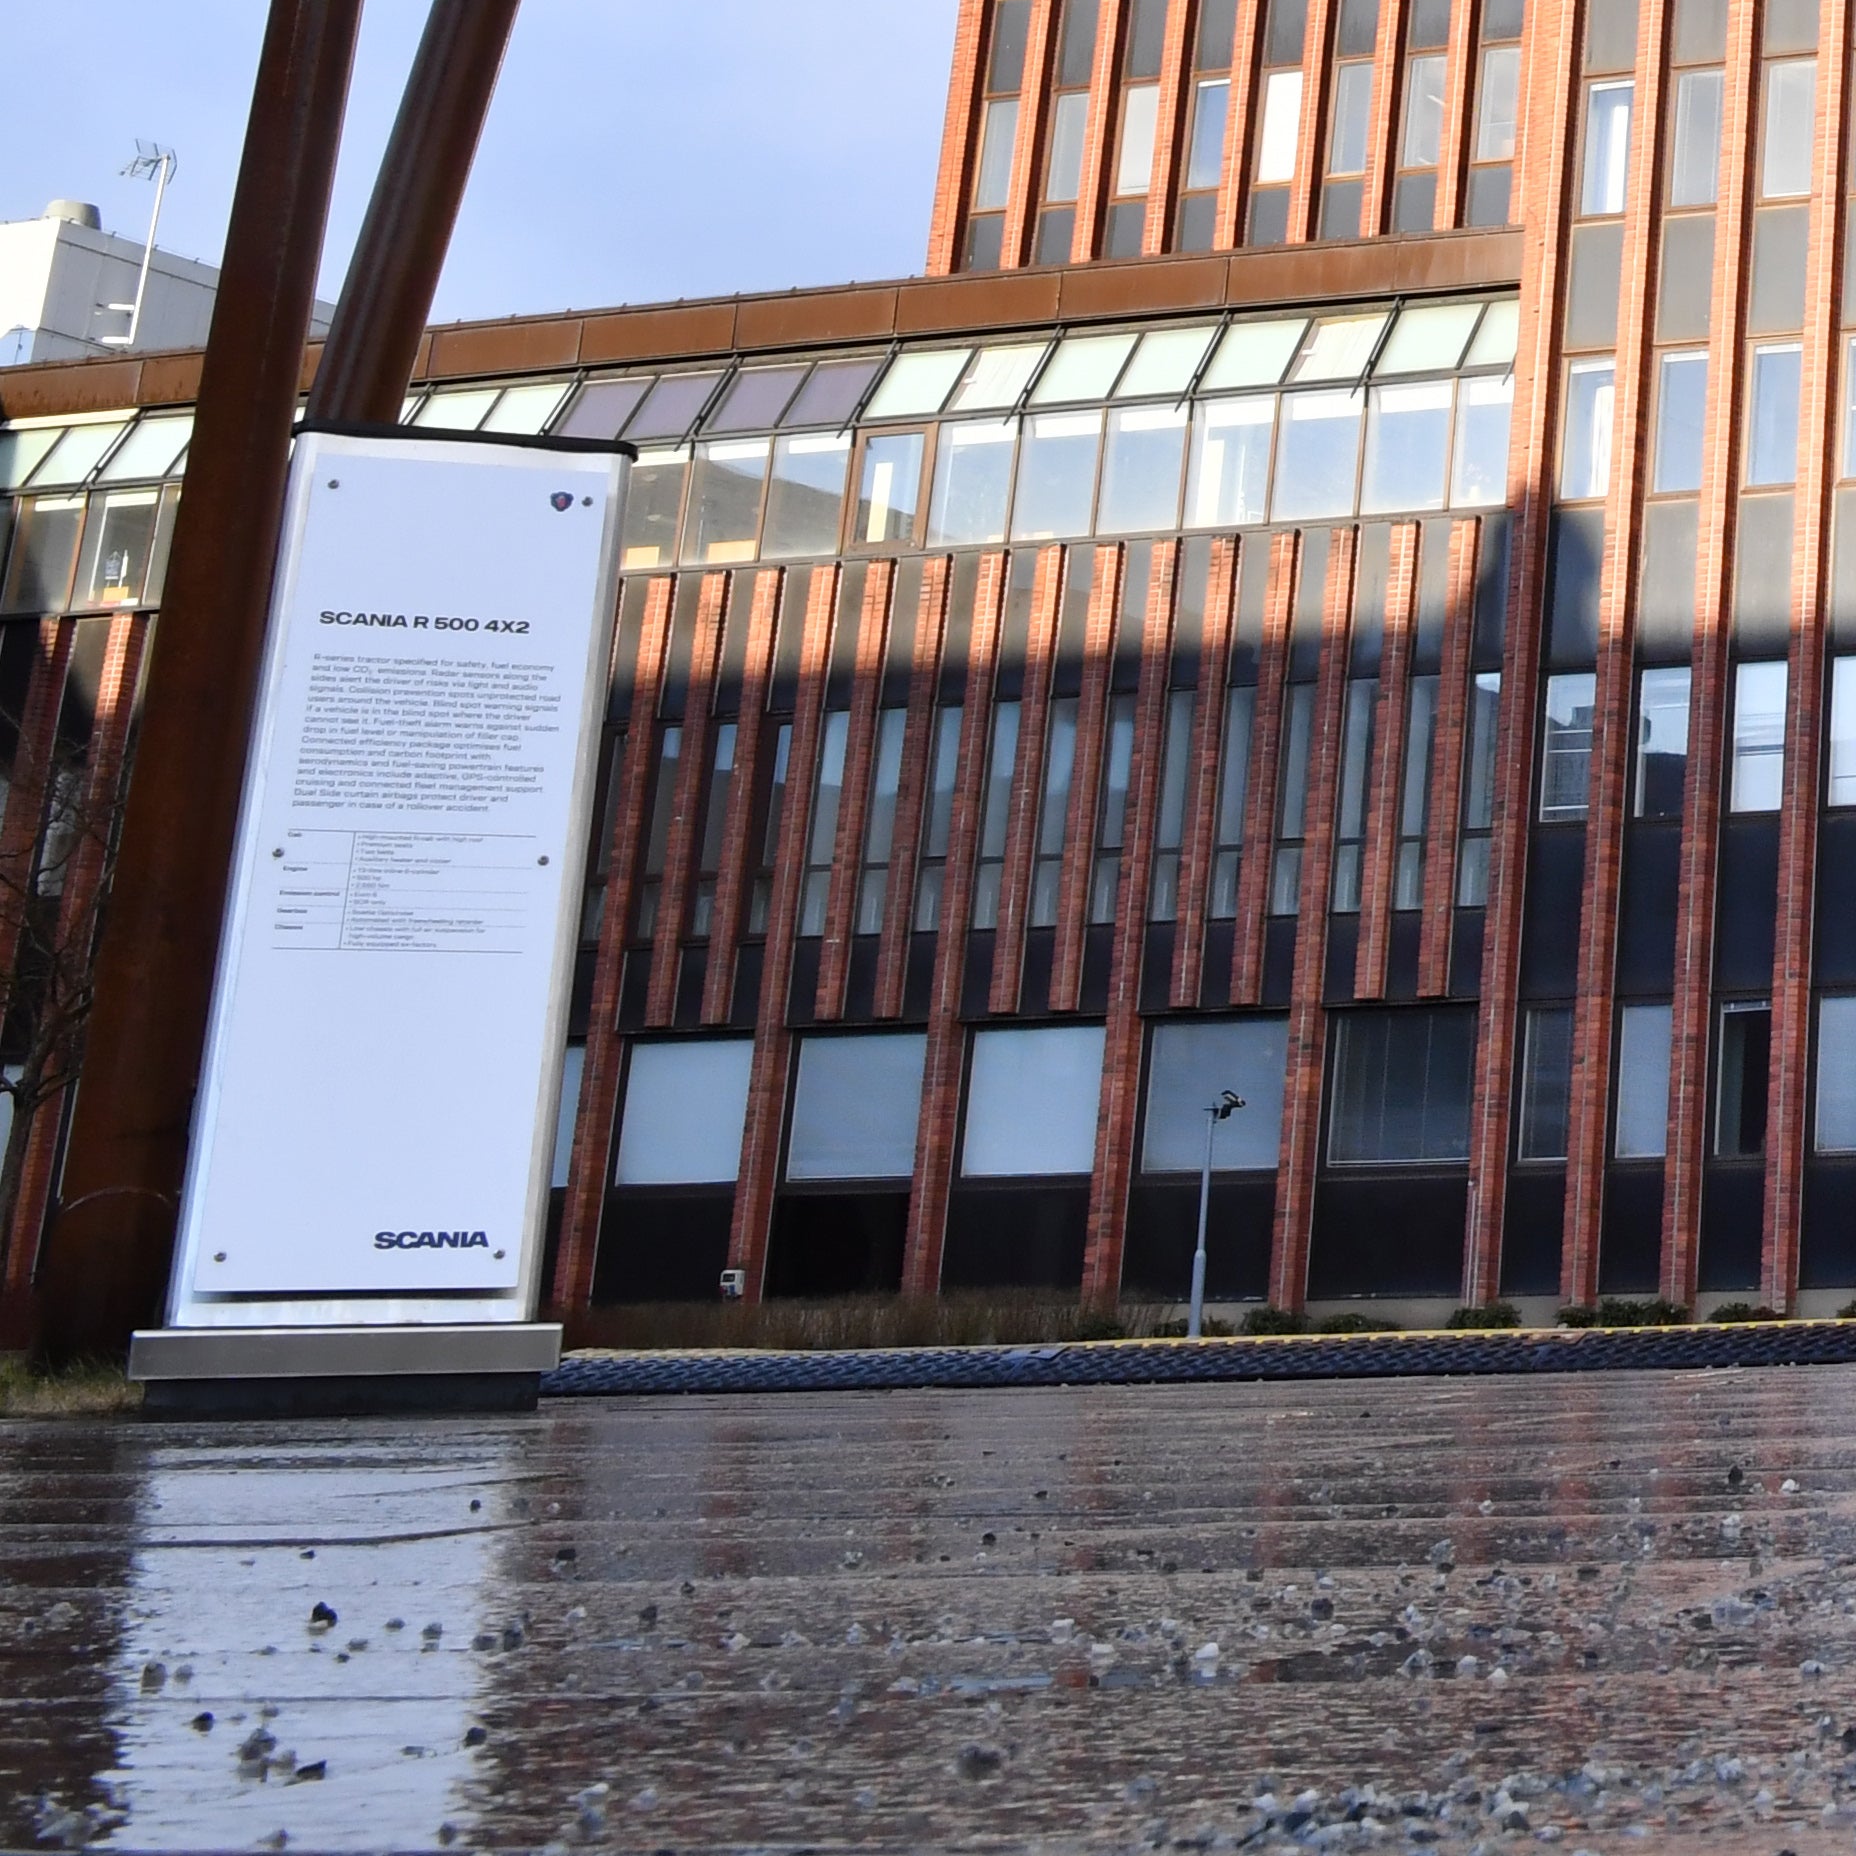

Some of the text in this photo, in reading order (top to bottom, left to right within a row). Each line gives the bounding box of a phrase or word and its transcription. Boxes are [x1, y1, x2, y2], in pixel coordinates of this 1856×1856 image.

[319, 610, 530, 634] SCANIA R 500 4X2
[373, 1230, 490, 1250] SCANIA
